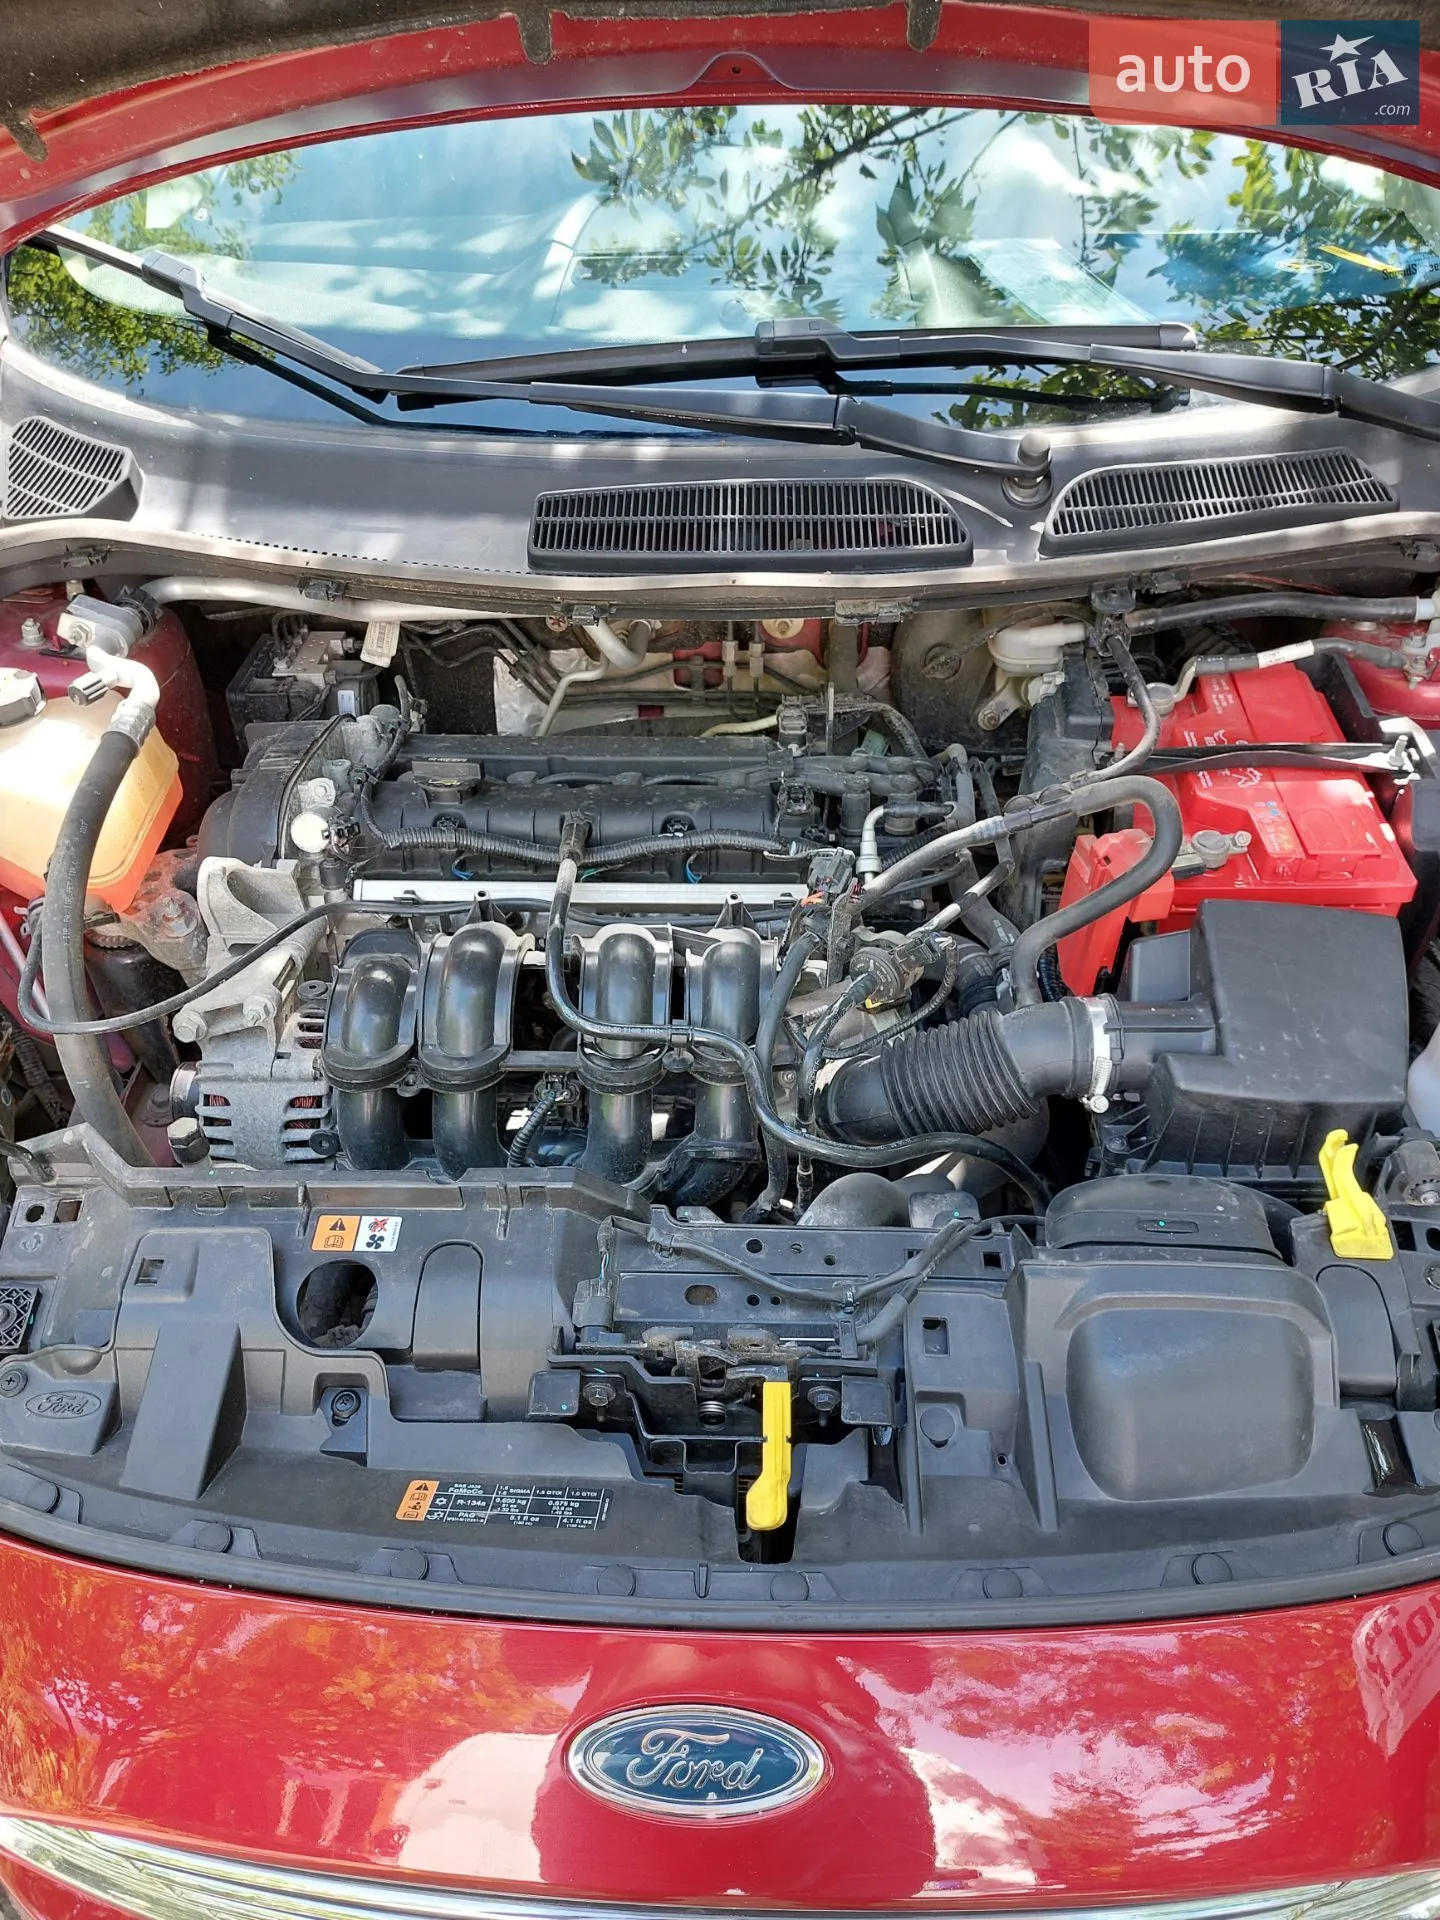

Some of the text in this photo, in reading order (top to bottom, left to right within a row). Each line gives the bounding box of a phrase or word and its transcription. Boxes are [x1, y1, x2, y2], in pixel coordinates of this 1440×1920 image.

[38, 1394, 88, 1414] Ford
[448, 1487, 484, 1495] FoMoCo
[626, 1728, 763, 1790] Ford
